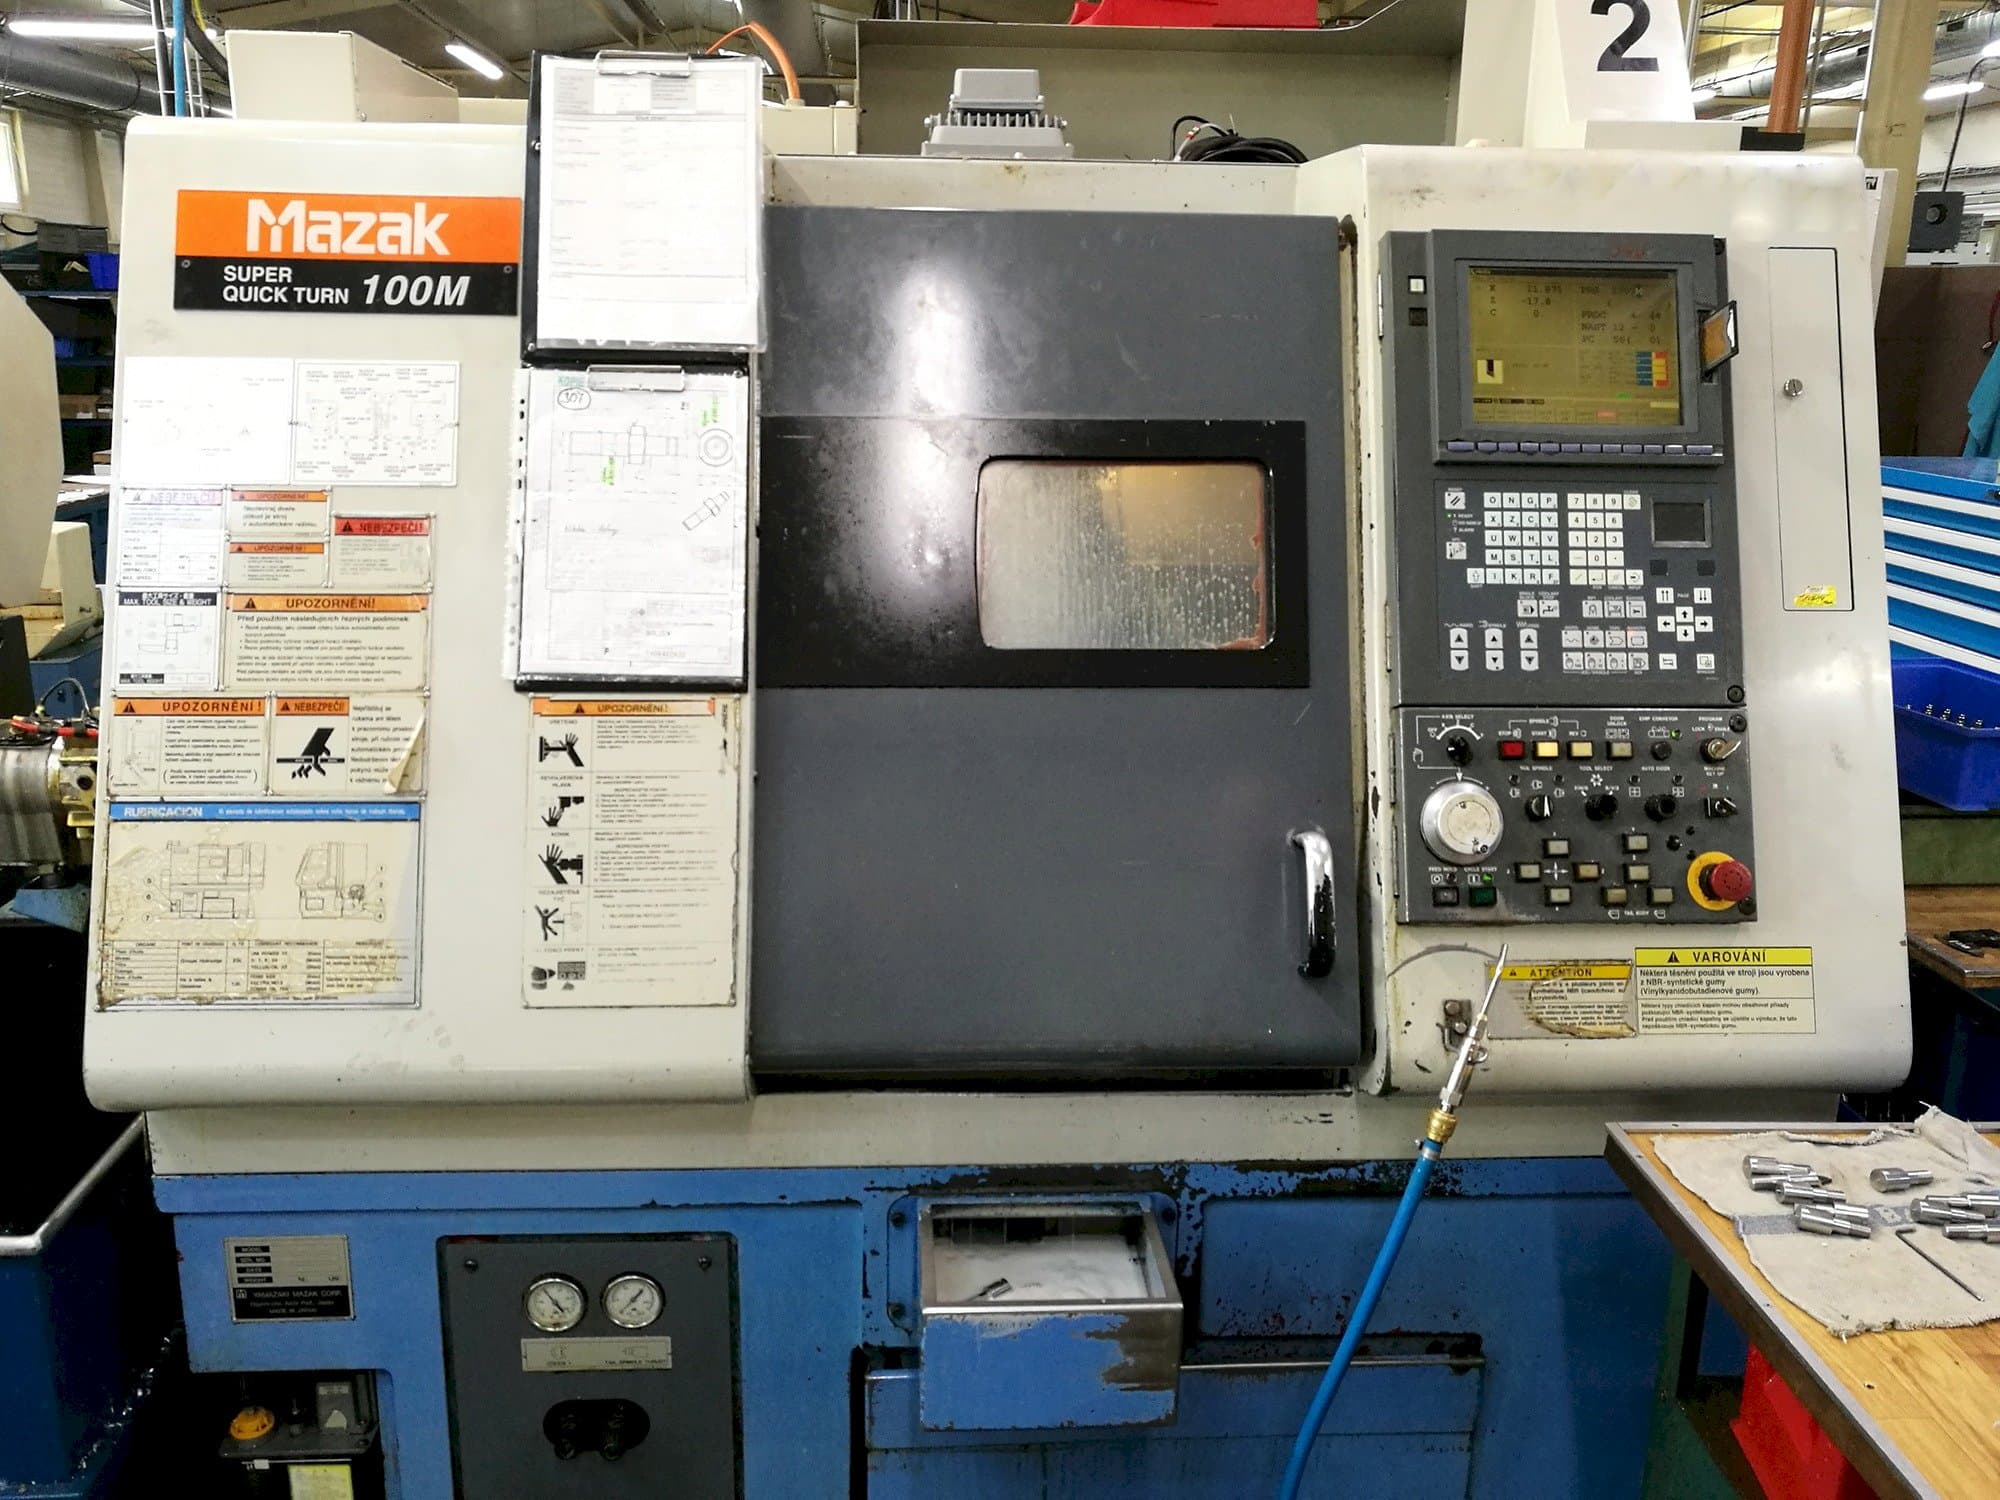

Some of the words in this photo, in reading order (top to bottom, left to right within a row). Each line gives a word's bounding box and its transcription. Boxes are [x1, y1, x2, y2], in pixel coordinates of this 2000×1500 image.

[1591, 0, 1659, 72] 2
[247, 199, 449, 255] Mazak
[224, 266, 292, 283] SUPER
[223, 286, 288, 304] QUICK
[293, 288, 349, 304] TURN
[363, 274, 470, 306] 100M
[286, 596, 375, 608] UPOZORNĚNÍ!
[1693, 950, 1766, 962] VAROVÁNÍ
[1530, 968, 1592, 978] ATTENTION
[1640, 969, 1668, 977] Některá
[1669, 969, 1696, 977] těsnění
[1698, 969, 1724, 977] použitá
[1727, 969, 1736, 977] ve
[1738, 969, 1756, 977] stroji
[1758, 969, 1773, 977] jsou
[1776, 969, 1809, 977] vyrobena
